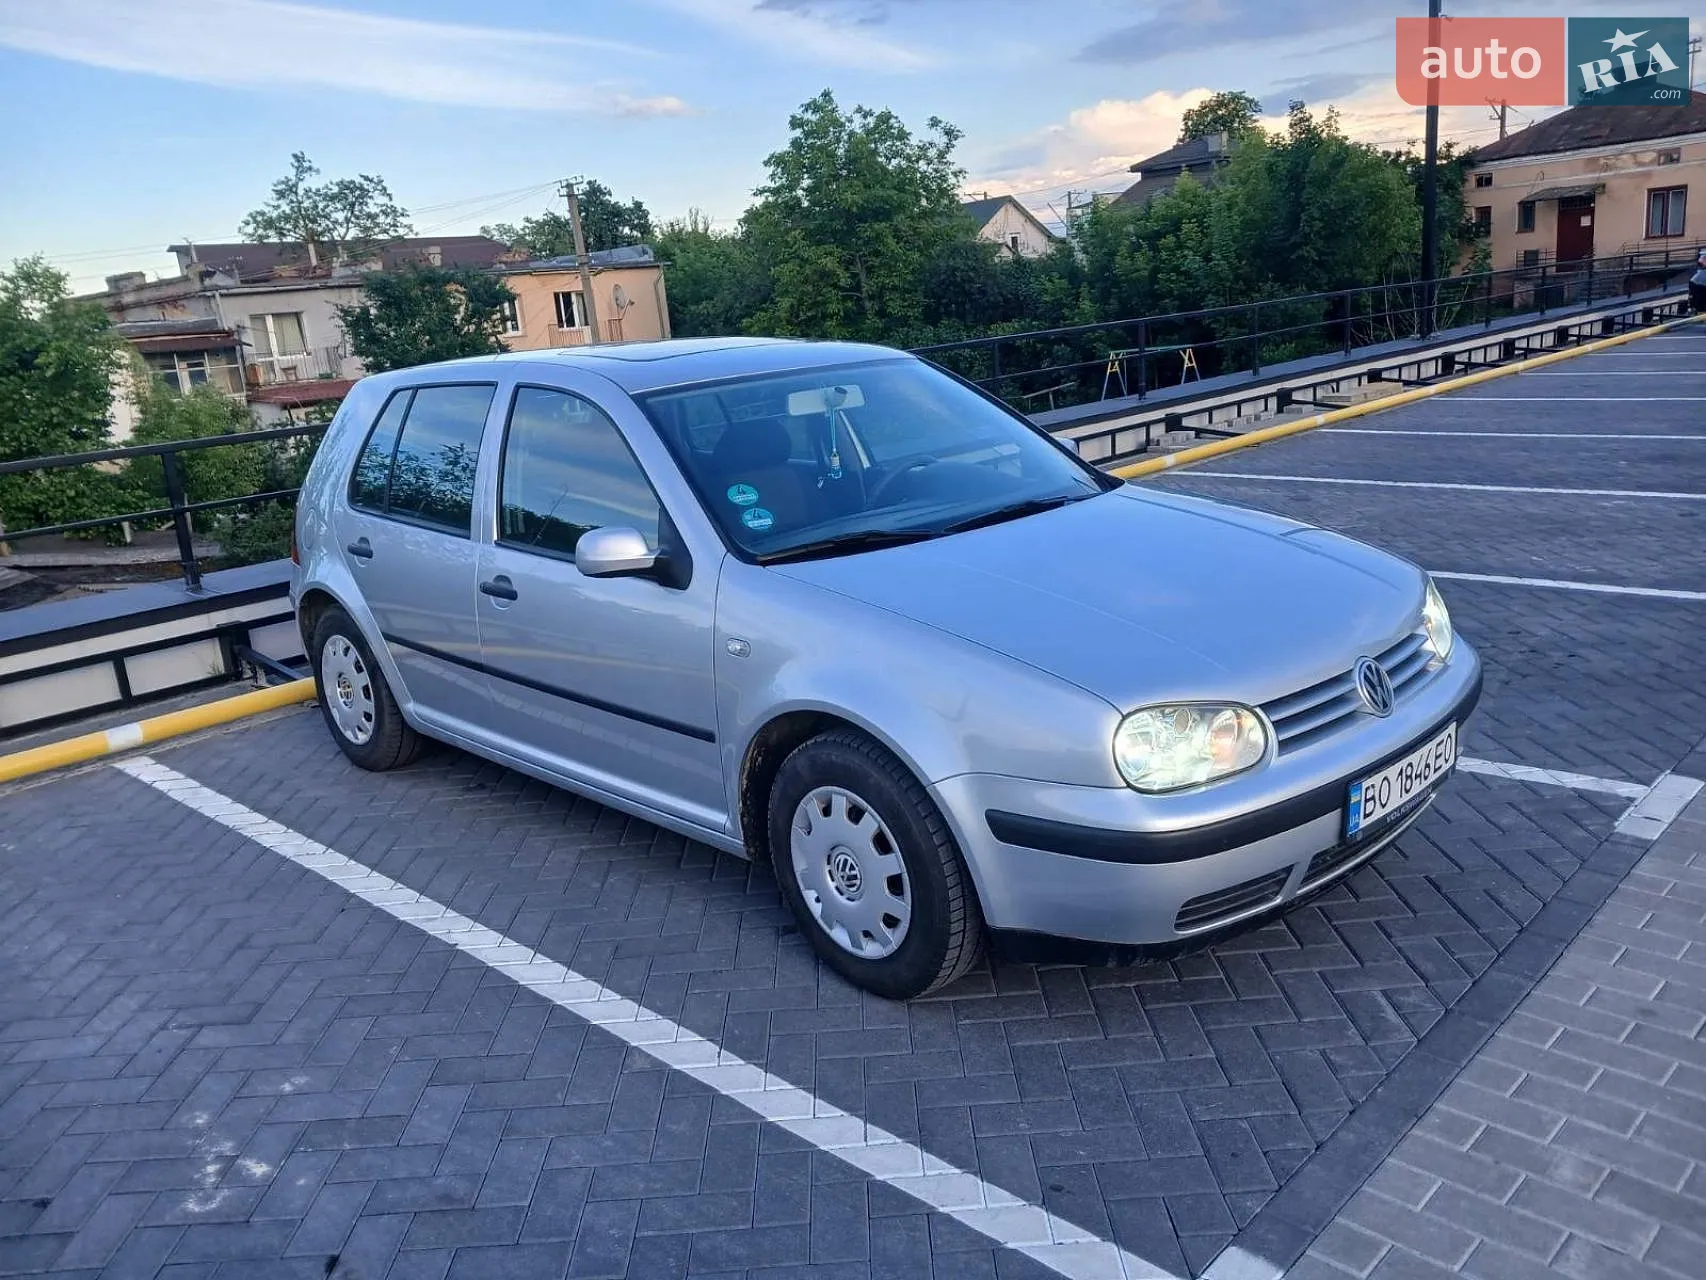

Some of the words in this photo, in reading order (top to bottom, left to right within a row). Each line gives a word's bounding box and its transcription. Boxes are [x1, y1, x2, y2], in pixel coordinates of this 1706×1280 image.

[1360, 658, 1393, 715] VW
[1363, 776, 1391, 820] BO
[1395, 746, 1433, 798] 1846
